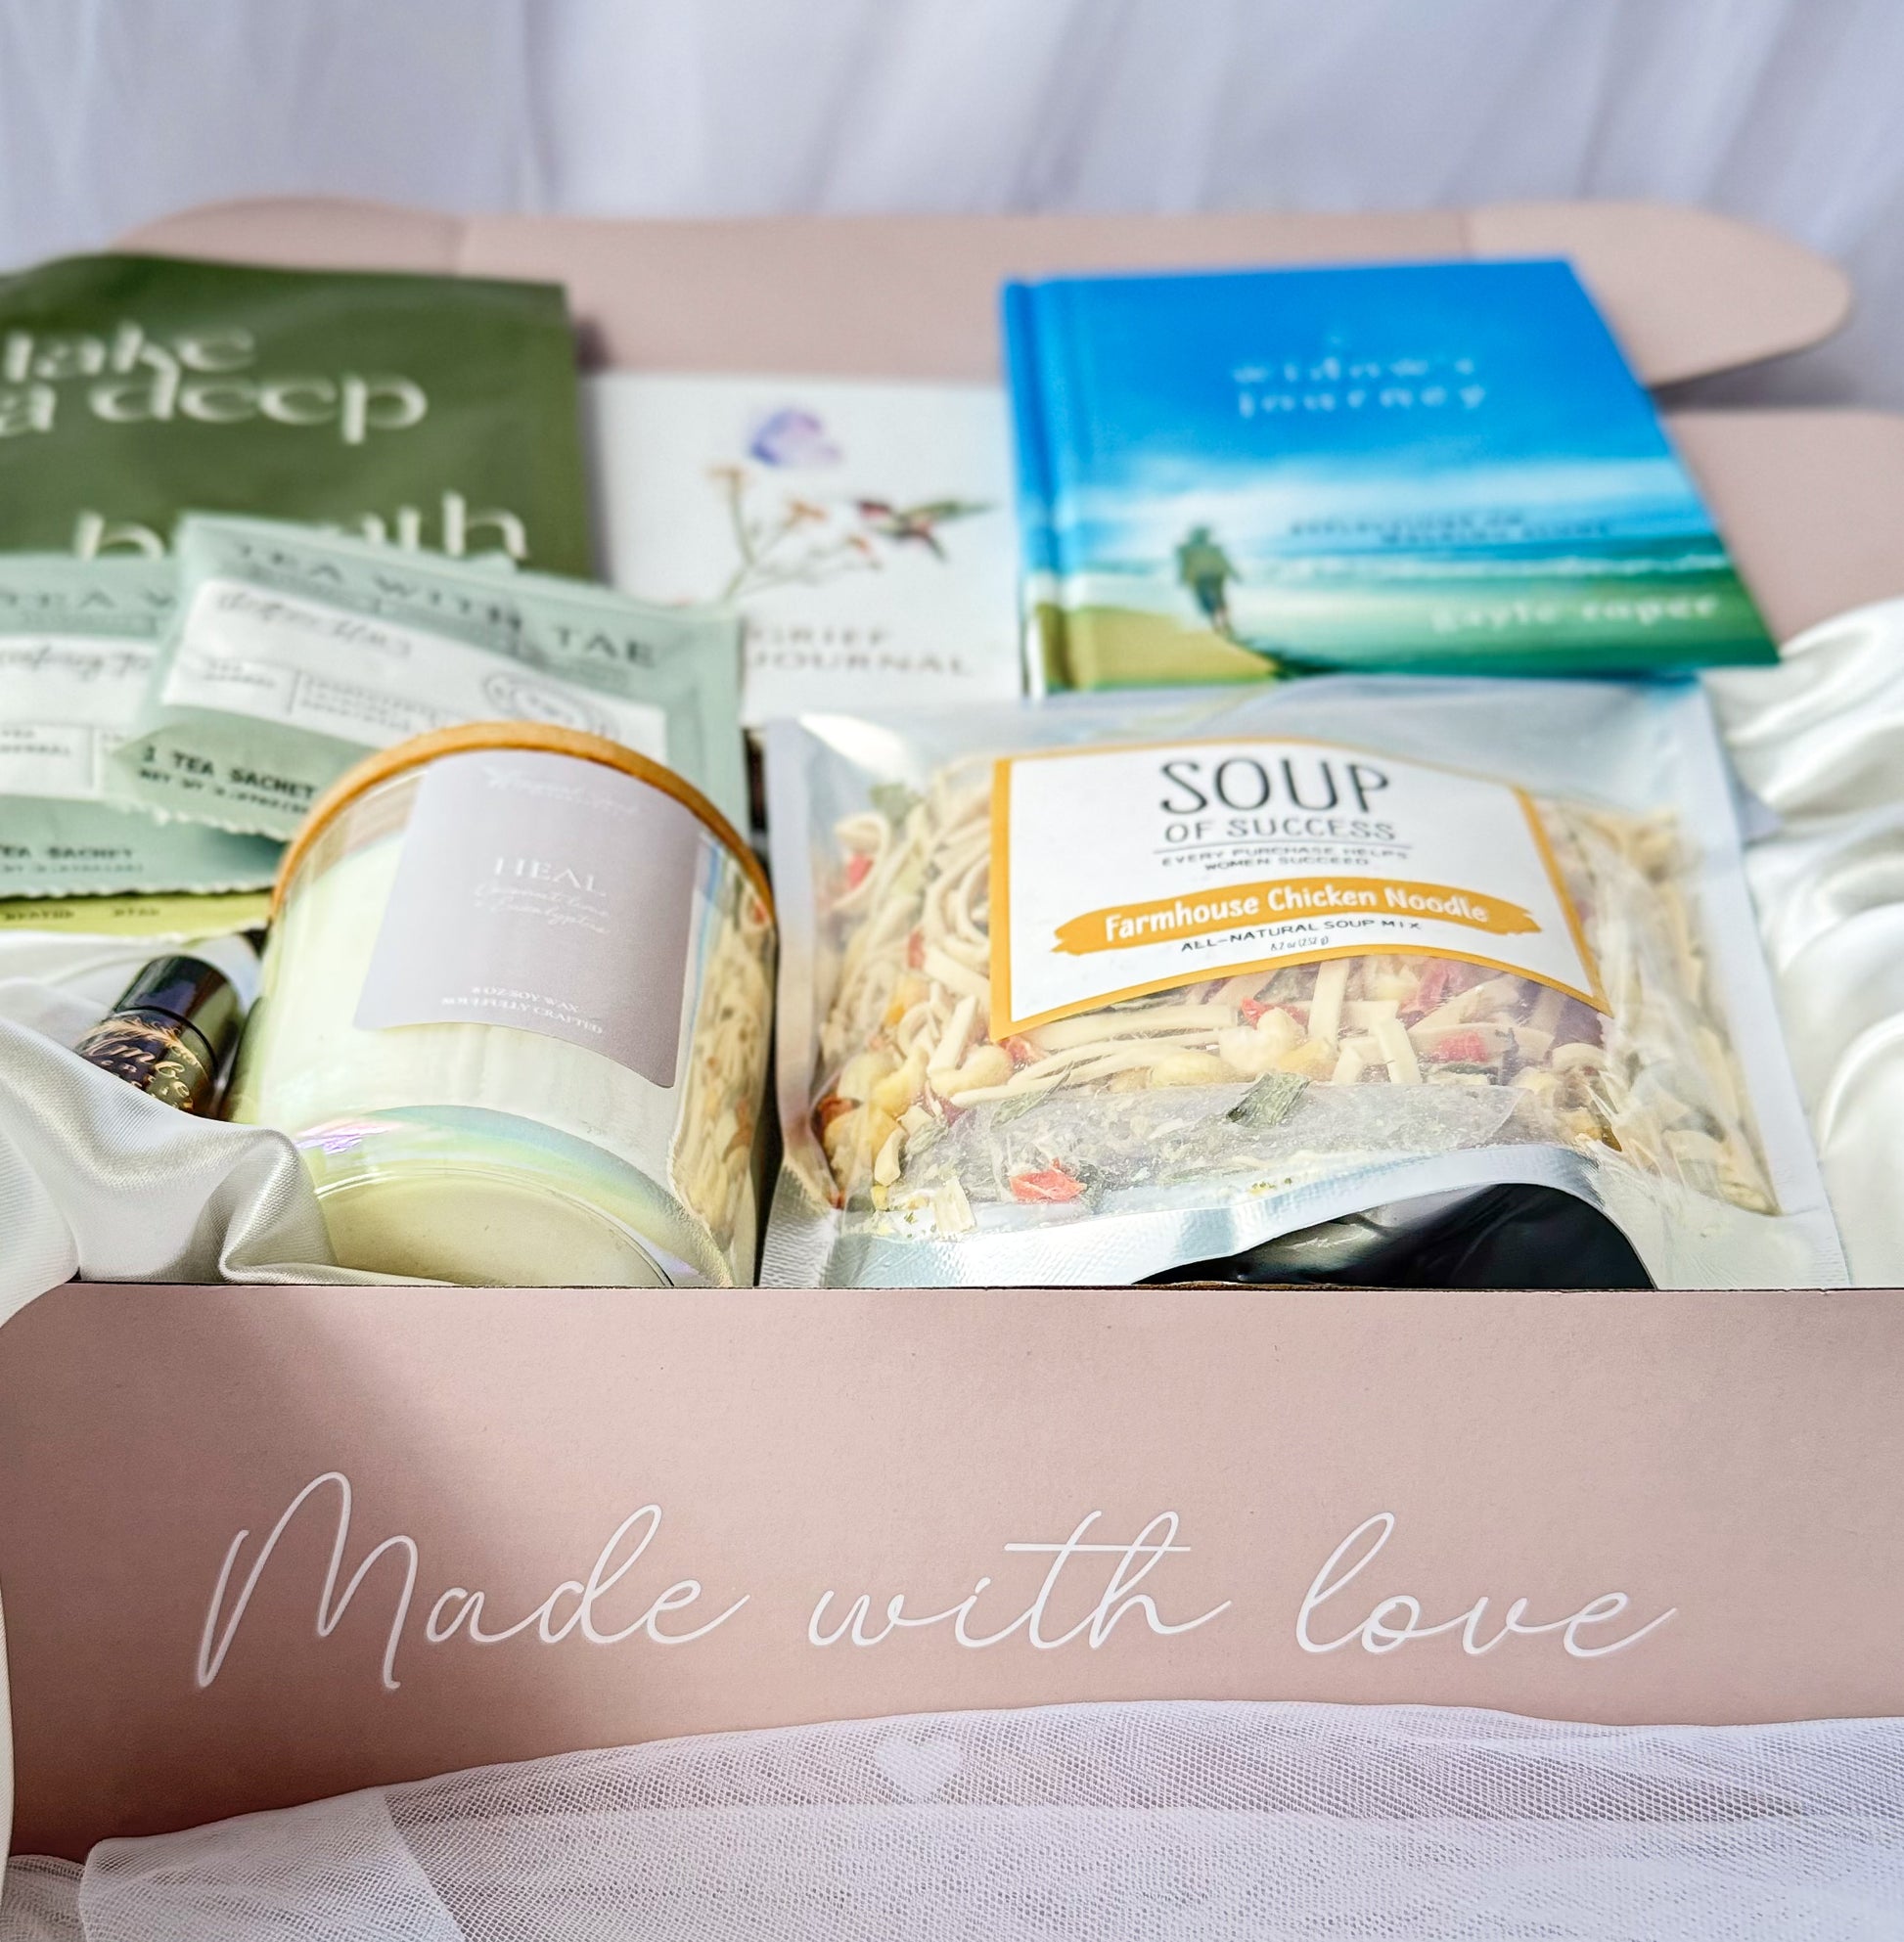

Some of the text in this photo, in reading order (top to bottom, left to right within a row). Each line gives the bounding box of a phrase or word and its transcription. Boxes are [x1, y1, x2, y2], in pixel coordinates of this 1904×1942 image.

[89, 354, 428, 444] deep
[550, 624, 658, 666] TAE
[172, 750, 215, 777] TEA
[229, 768, 317, 800] SACHET
[1158, 757, 1391, 815] SOUP
[1164, 818, 1397, 845] OF SUCCESS
[1161, 845, 1409, 867] EVERY PURCHASE HELPS
[1204, 858, 1270, 871] WOMEN
[494, 857, 607, 897] HEAL
[1105, 883, 1489, 942] Farmhouse Chicken Noodle
[1180, 923, 1319, 953] ALL-NATURAL
[1324, 918, 1376, 931] SOUP
[533, 1008, 604, 1035] CRAFTED
[543, 996, 580, 1014] WAX
[198, 1470, 1678, 1693] Made with love
